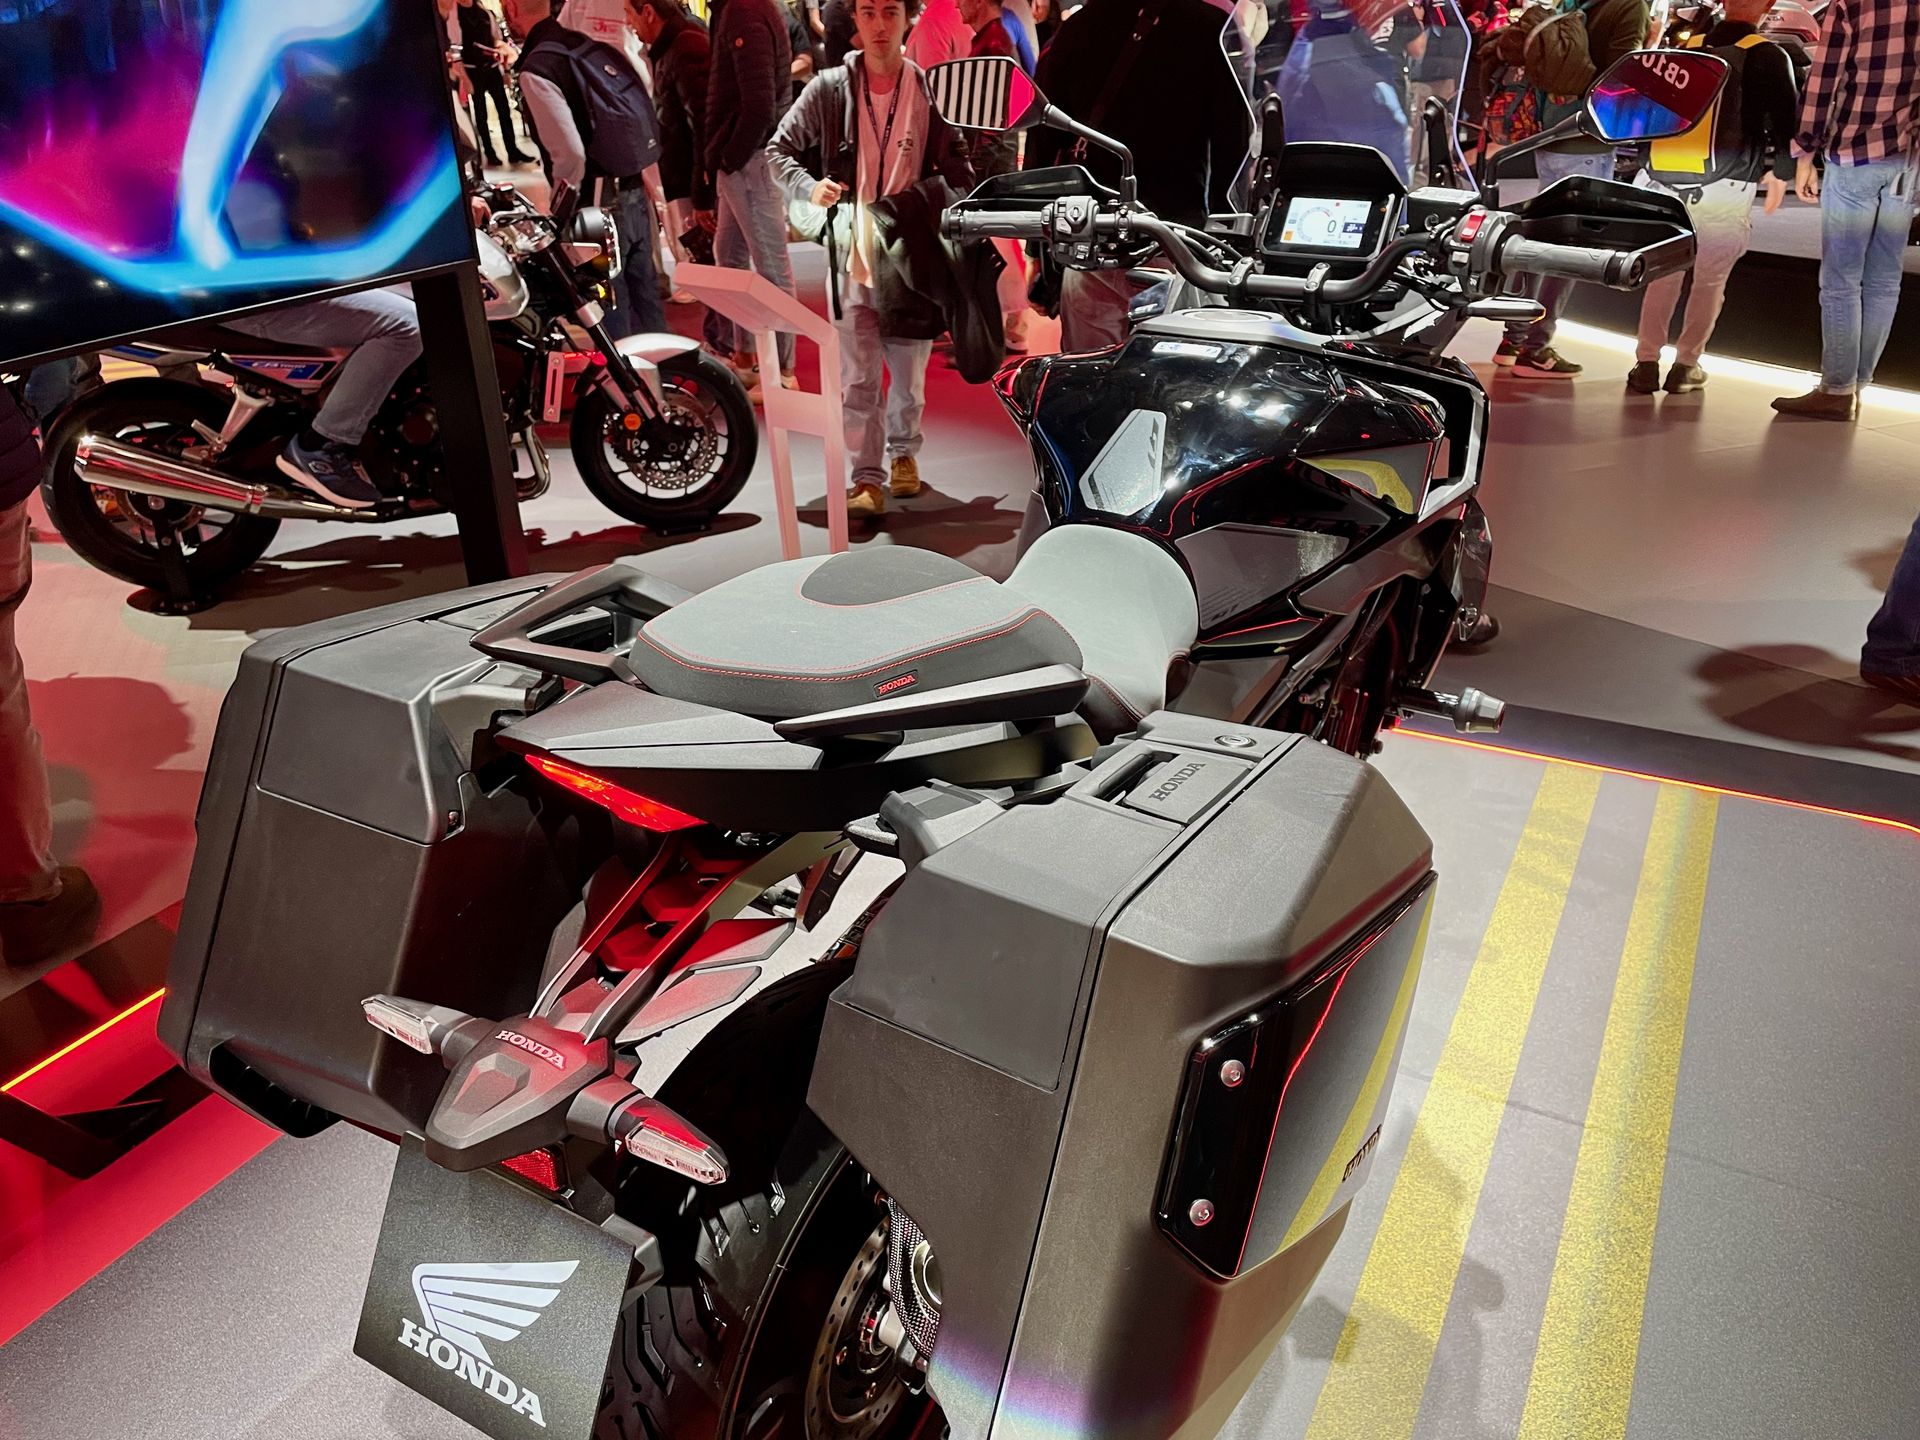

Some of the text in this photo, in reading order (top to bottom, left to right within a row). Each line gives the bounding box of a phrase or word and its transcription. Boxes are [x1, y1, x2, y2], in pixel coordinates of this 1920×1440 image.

[878, 674, 916, 694] HONDA
[1148, 761, 1206, 801] HONDA
[495, 1029, 566, 1071] HONDA
[397, 1317, 547, 1428] HONDA
